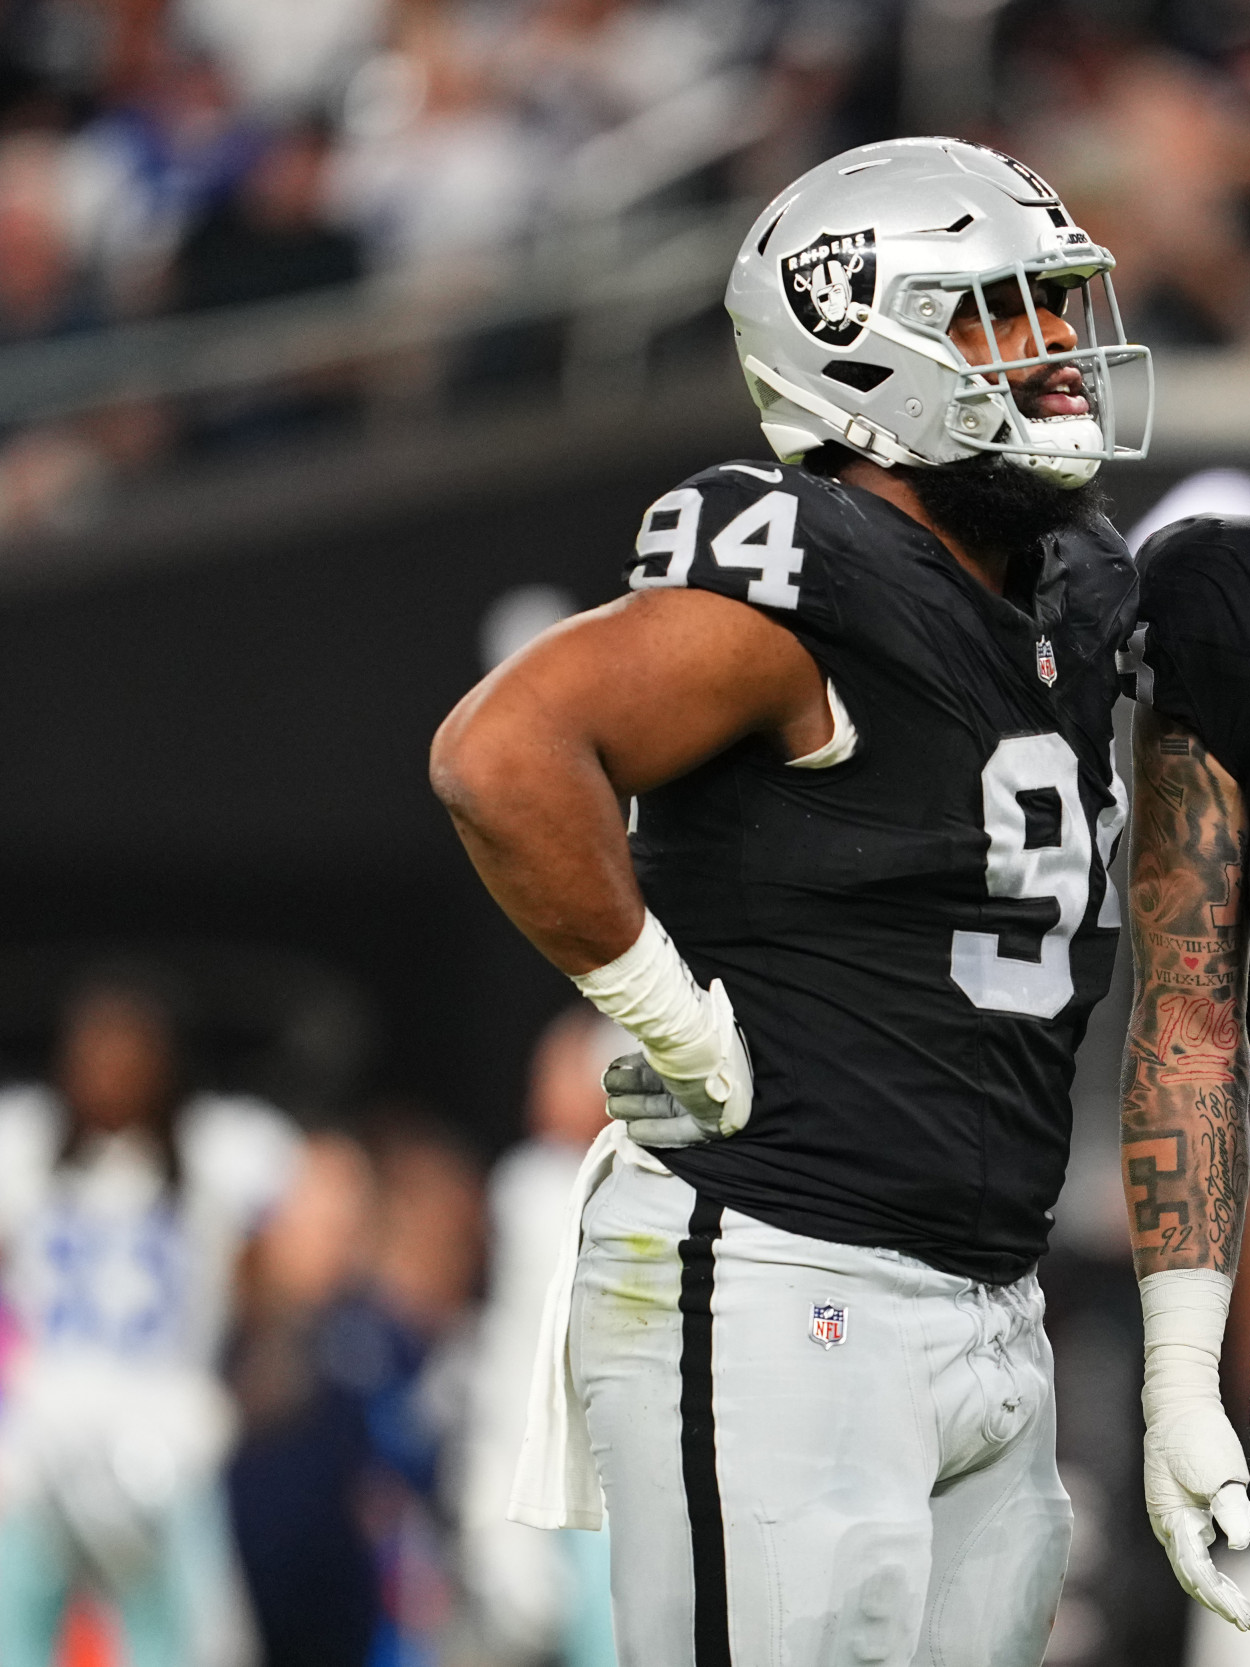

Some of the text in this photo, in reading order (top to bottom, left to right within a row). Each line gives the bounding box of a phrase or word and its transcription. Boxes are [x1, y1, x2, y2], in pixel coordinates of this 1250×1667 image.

[788, 233, 866, 271] RAIDERS
[628, 487, 805, 611] 94
[1160, 1225, 1195, 1256] 92
[816, 1320, 841, 1340] NFL
